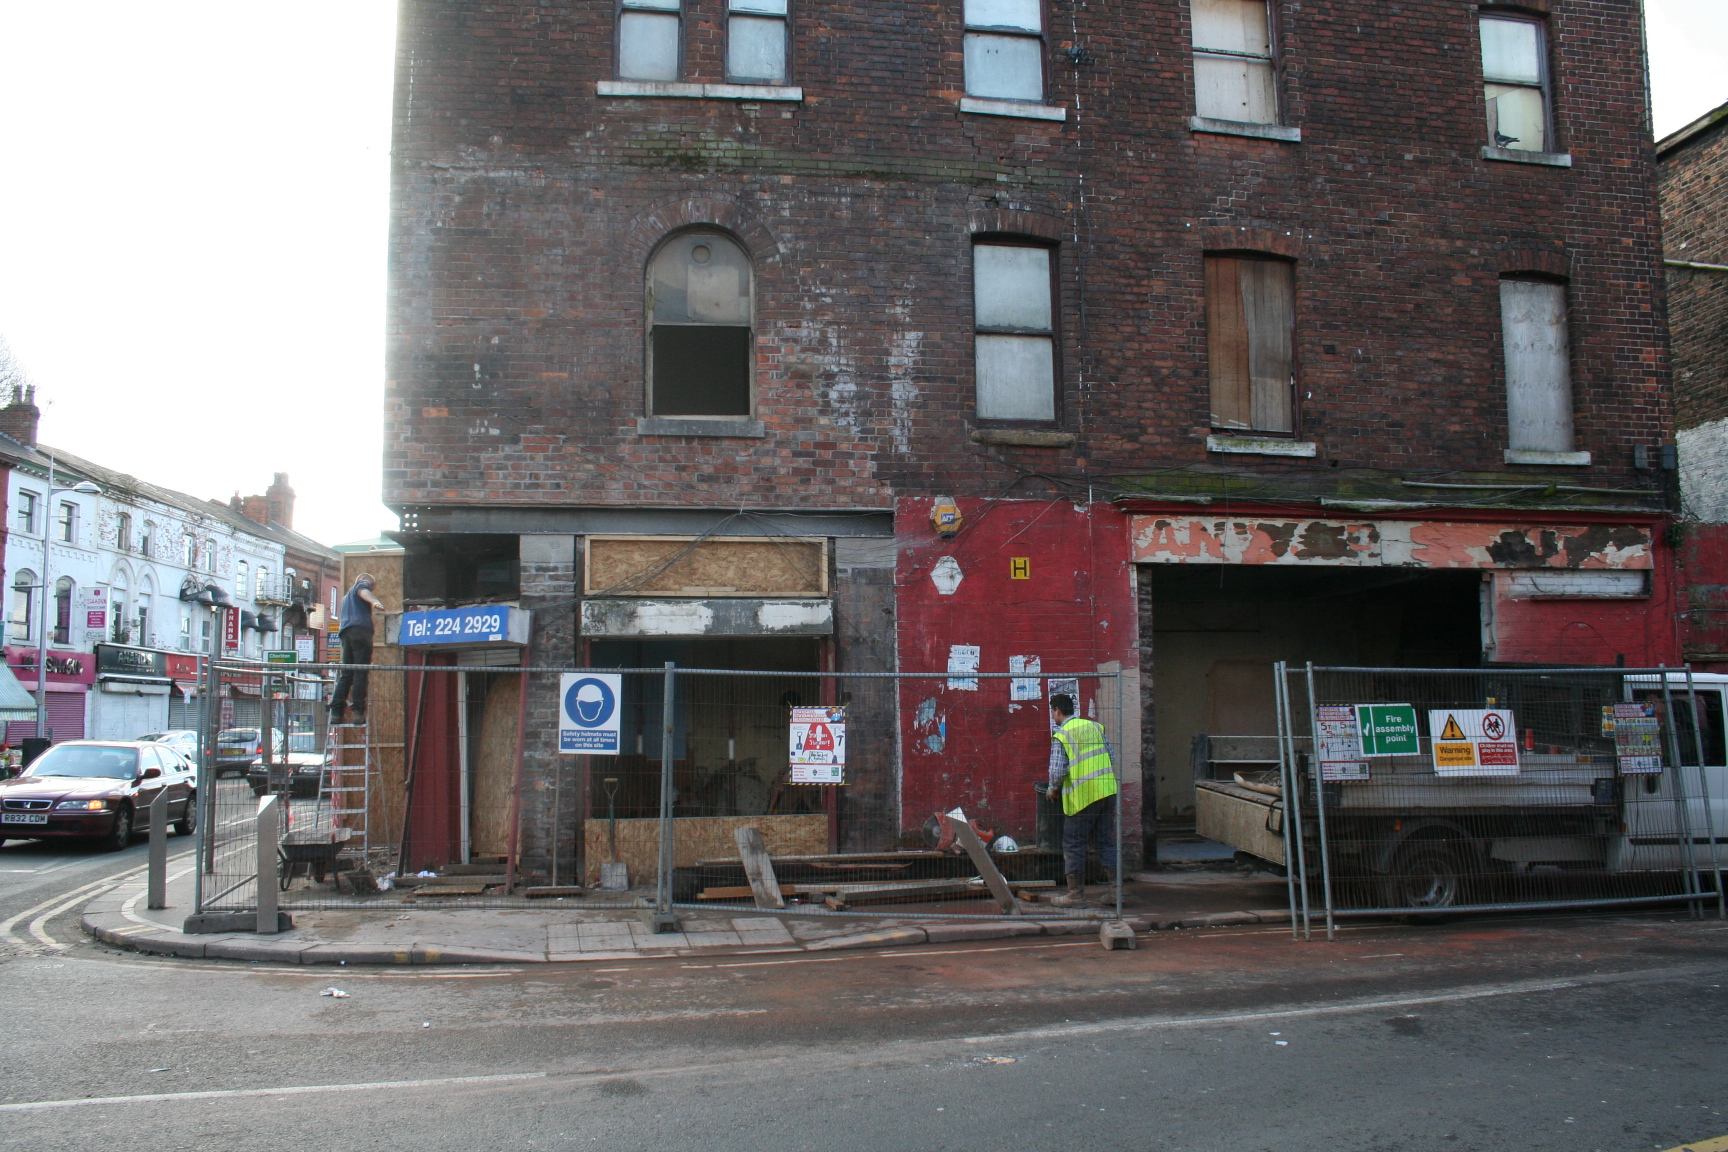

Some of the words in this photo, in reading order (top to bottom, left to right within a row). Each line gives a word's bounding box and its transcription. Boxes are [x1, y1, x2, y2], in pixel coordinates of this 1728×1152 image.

[1013, 559, 1027, 577] H
[407, 619, 431, 637] Tel:
[434, 617, 461, 635] 224
[464, 614, 501, 634] 2929
[1385, 715, 1402, 723] Fire
[1375, 724, 1414, 734] assembly
[1385, 734, 1407, 744] point
[1439, 746, 1471, 755] Warning
[4, 814, 26, 822] R832
